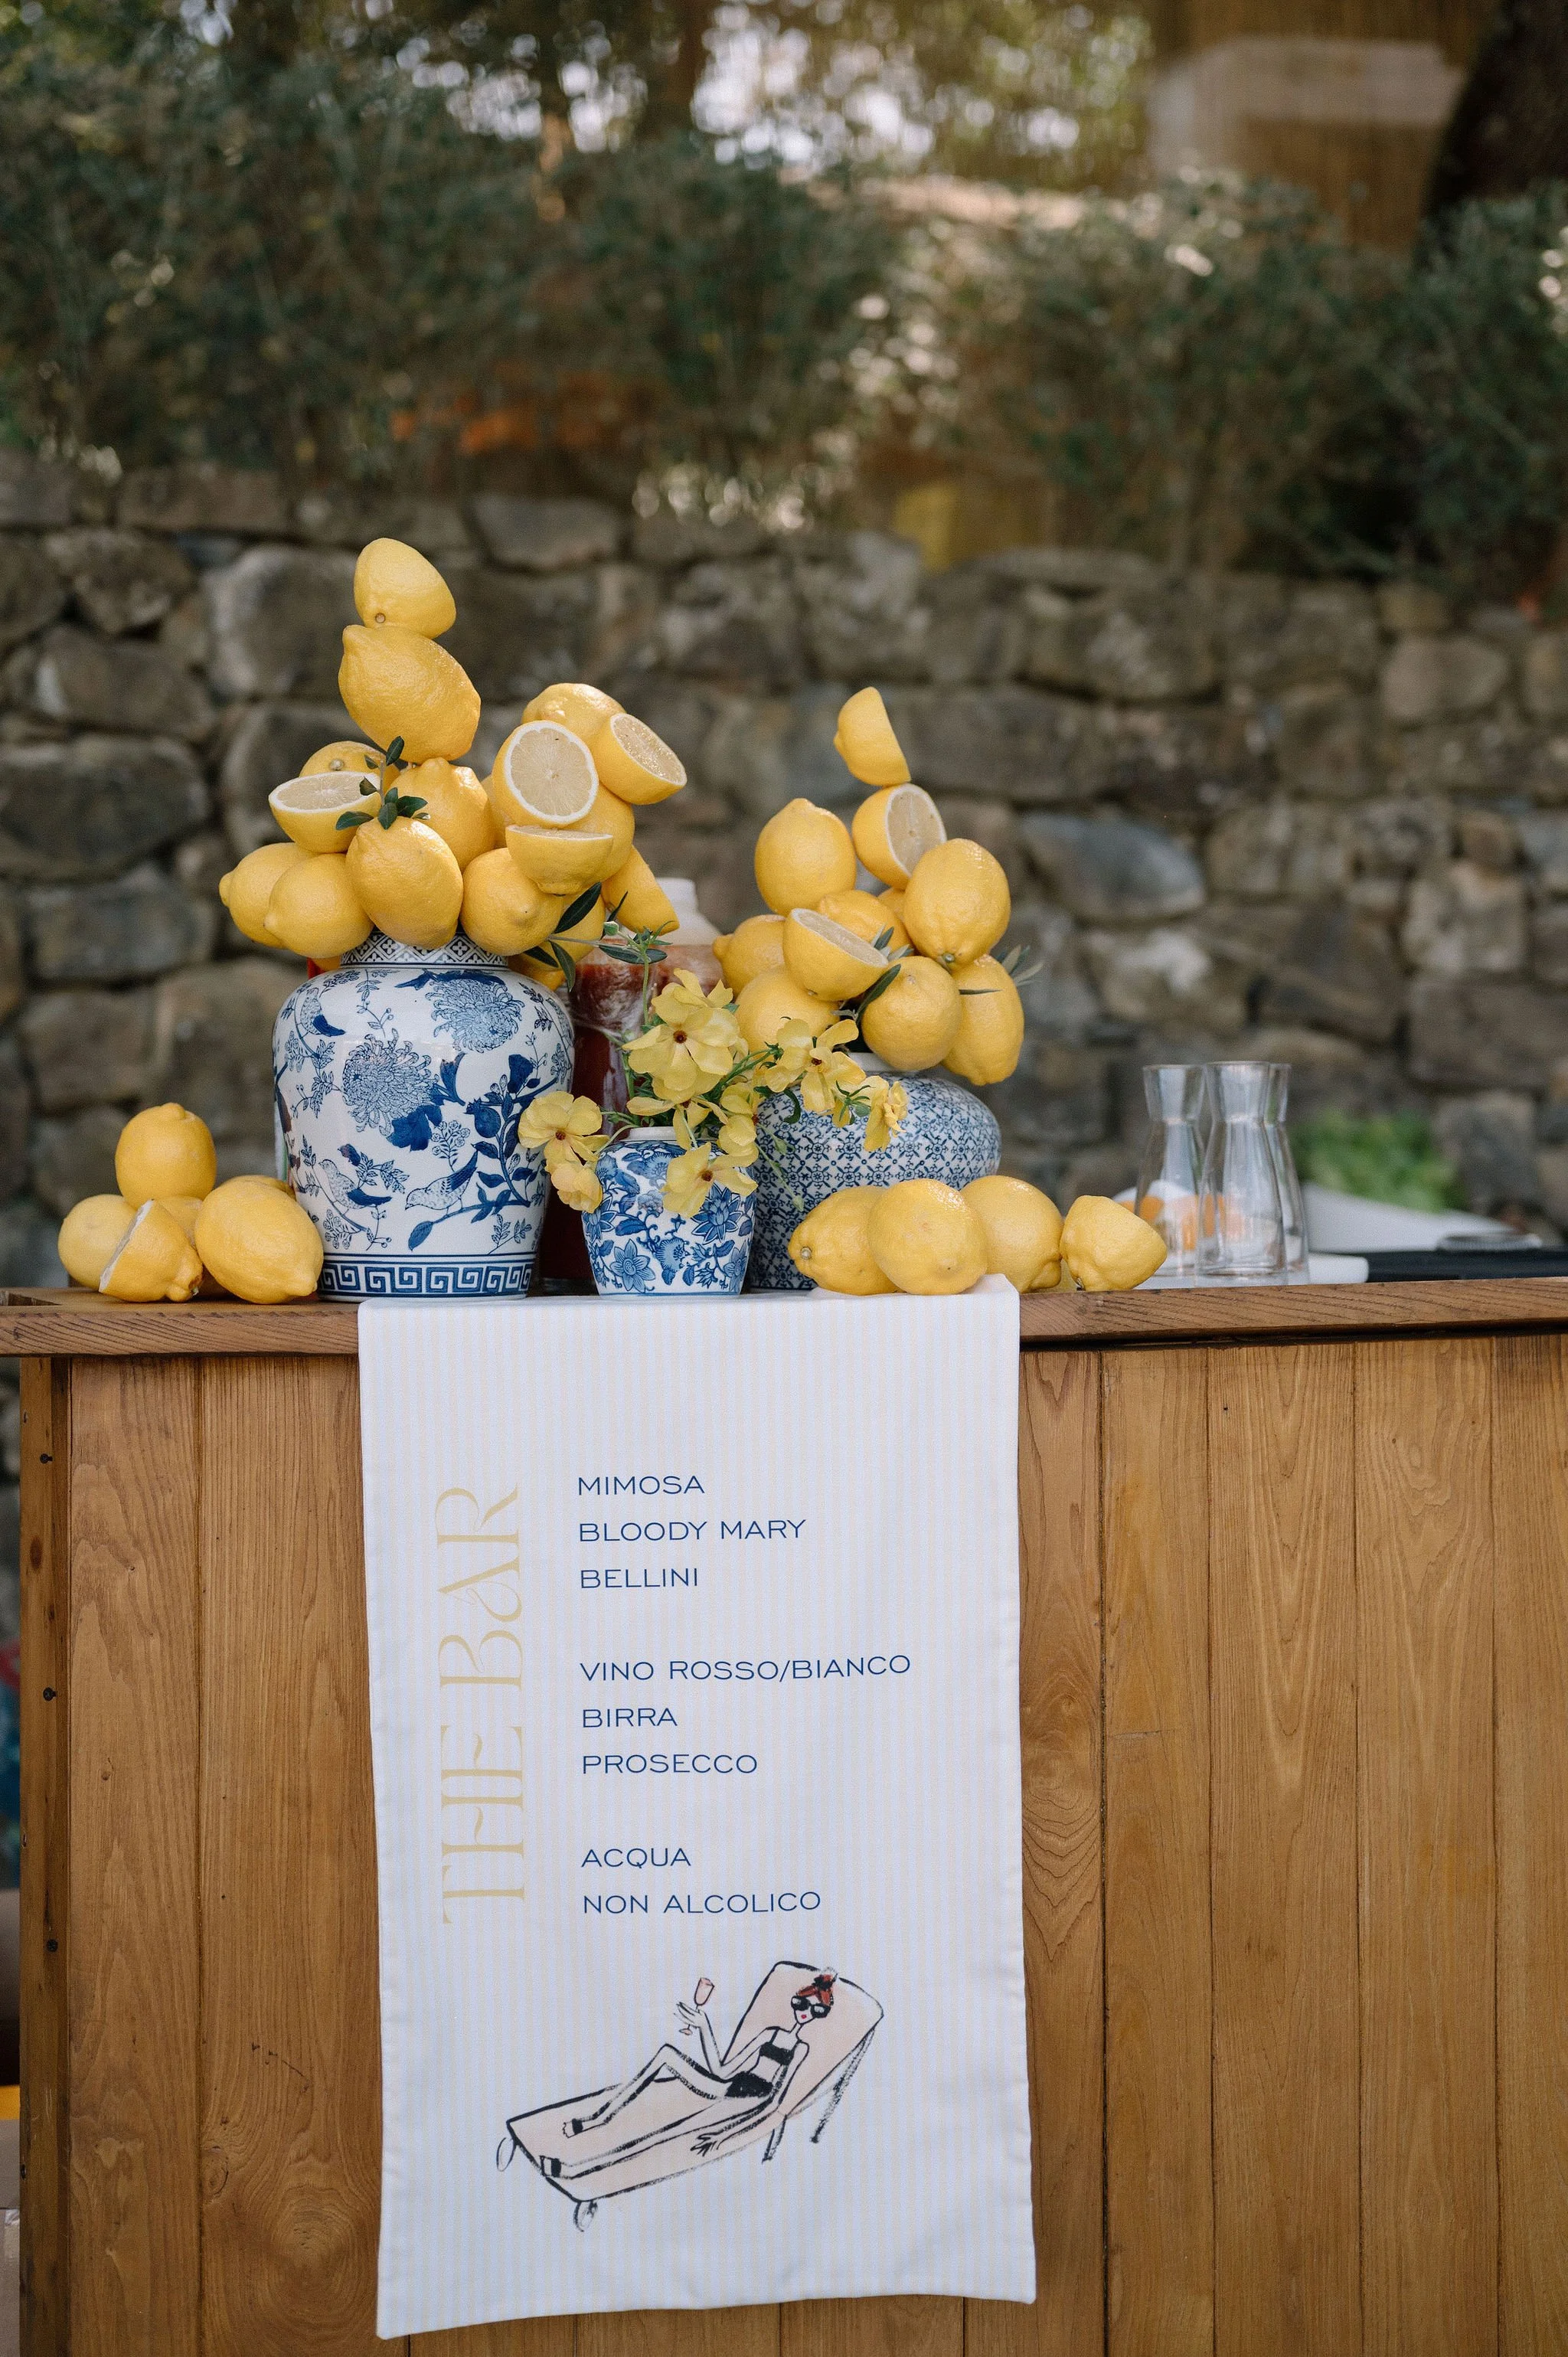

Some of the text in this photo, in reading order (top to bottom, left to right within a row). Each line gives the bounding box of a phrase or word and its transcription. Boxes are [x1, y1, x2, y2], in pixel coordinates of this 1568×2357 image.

[578, 1475, 705, 1496] MIMOSA
[580, 1519, 806, 1542] BLOODY MARY
[580, 1568, 697, 1589] BELLINI
[580, 1655, 910, 1682] VINO ROSSO/BIANCO
[435, 1484, 525, 1924] THE BAR
[583, 1708, 678, 1728] BIRRA
[583, 1754, 757, 1774] PROSECCO
[581, 1847, 691, 1869] ACQUA
[583, 1891, 821, 1914] NON ALCOLICO
